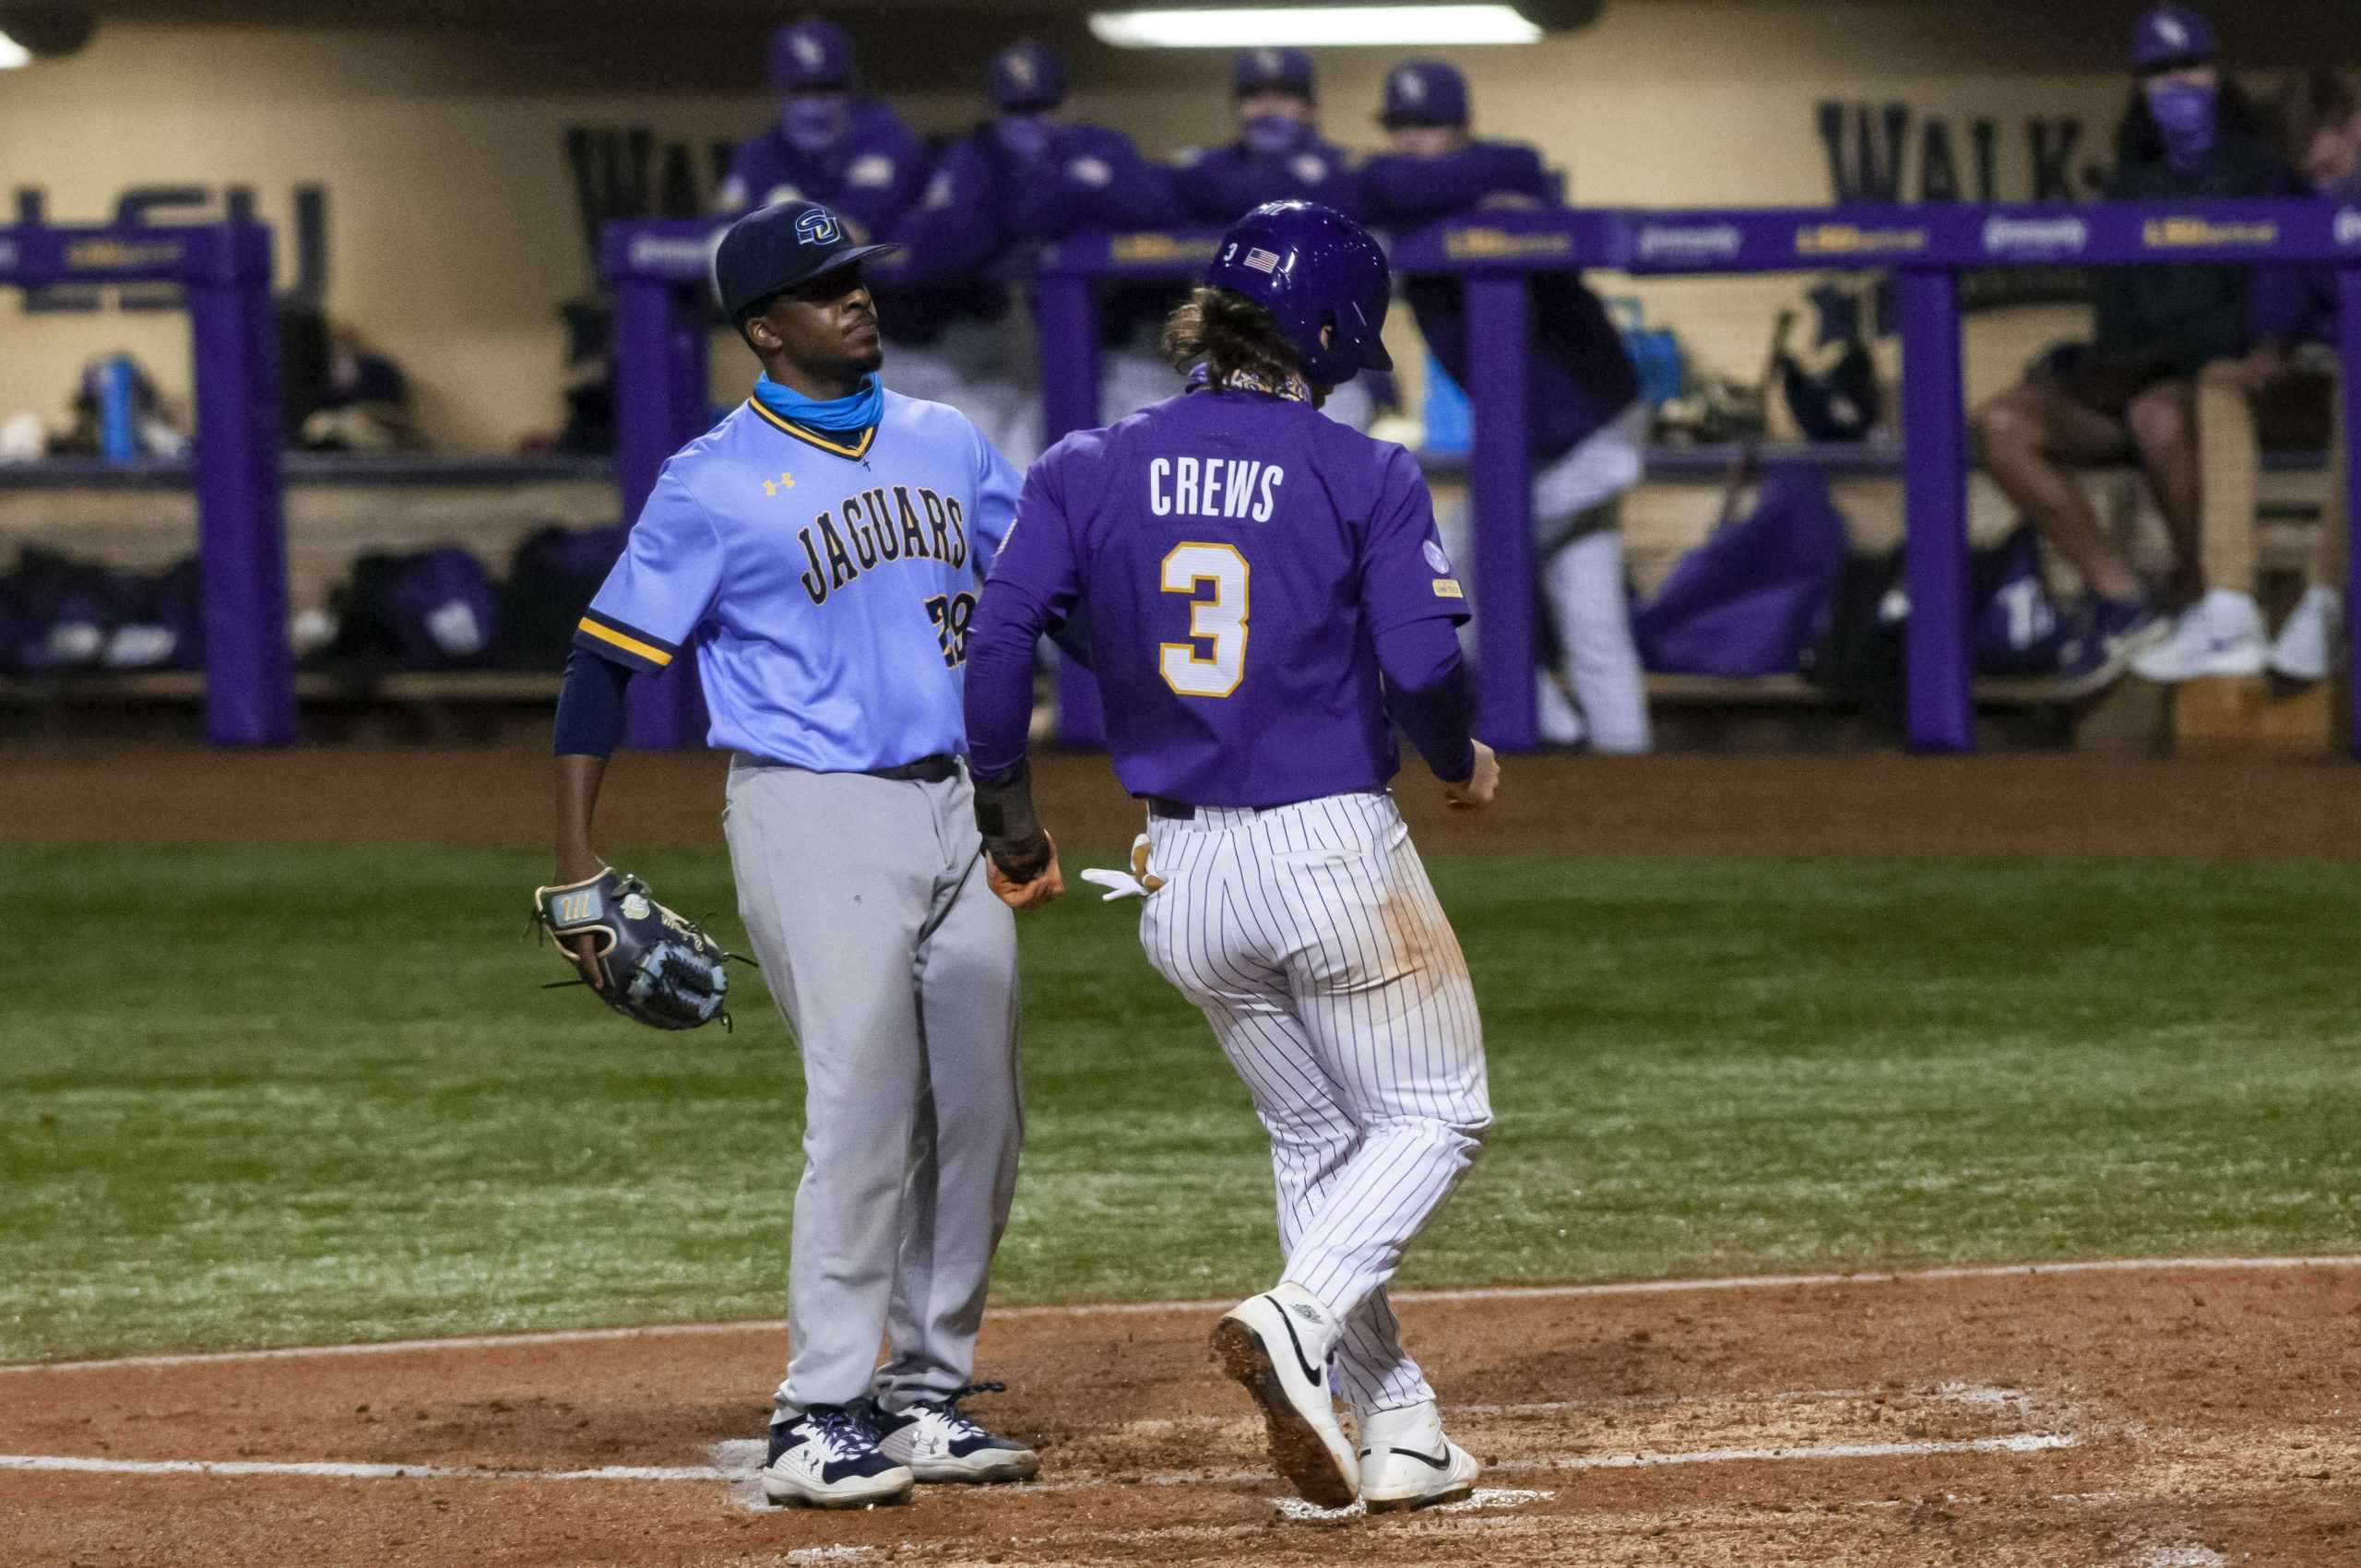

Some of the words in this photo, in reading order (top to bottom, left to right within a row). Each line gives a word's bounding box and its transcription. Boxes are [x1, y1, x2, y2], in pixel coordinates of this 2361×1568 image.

[796, 208, 840, 245] SU
[1223, 243, 1239, 261] 3
[1150, 457, 1285, 523] CREWS
[798, 485, 967, 605] JAGUARS
[1158, 540, 1251, 698] 3
